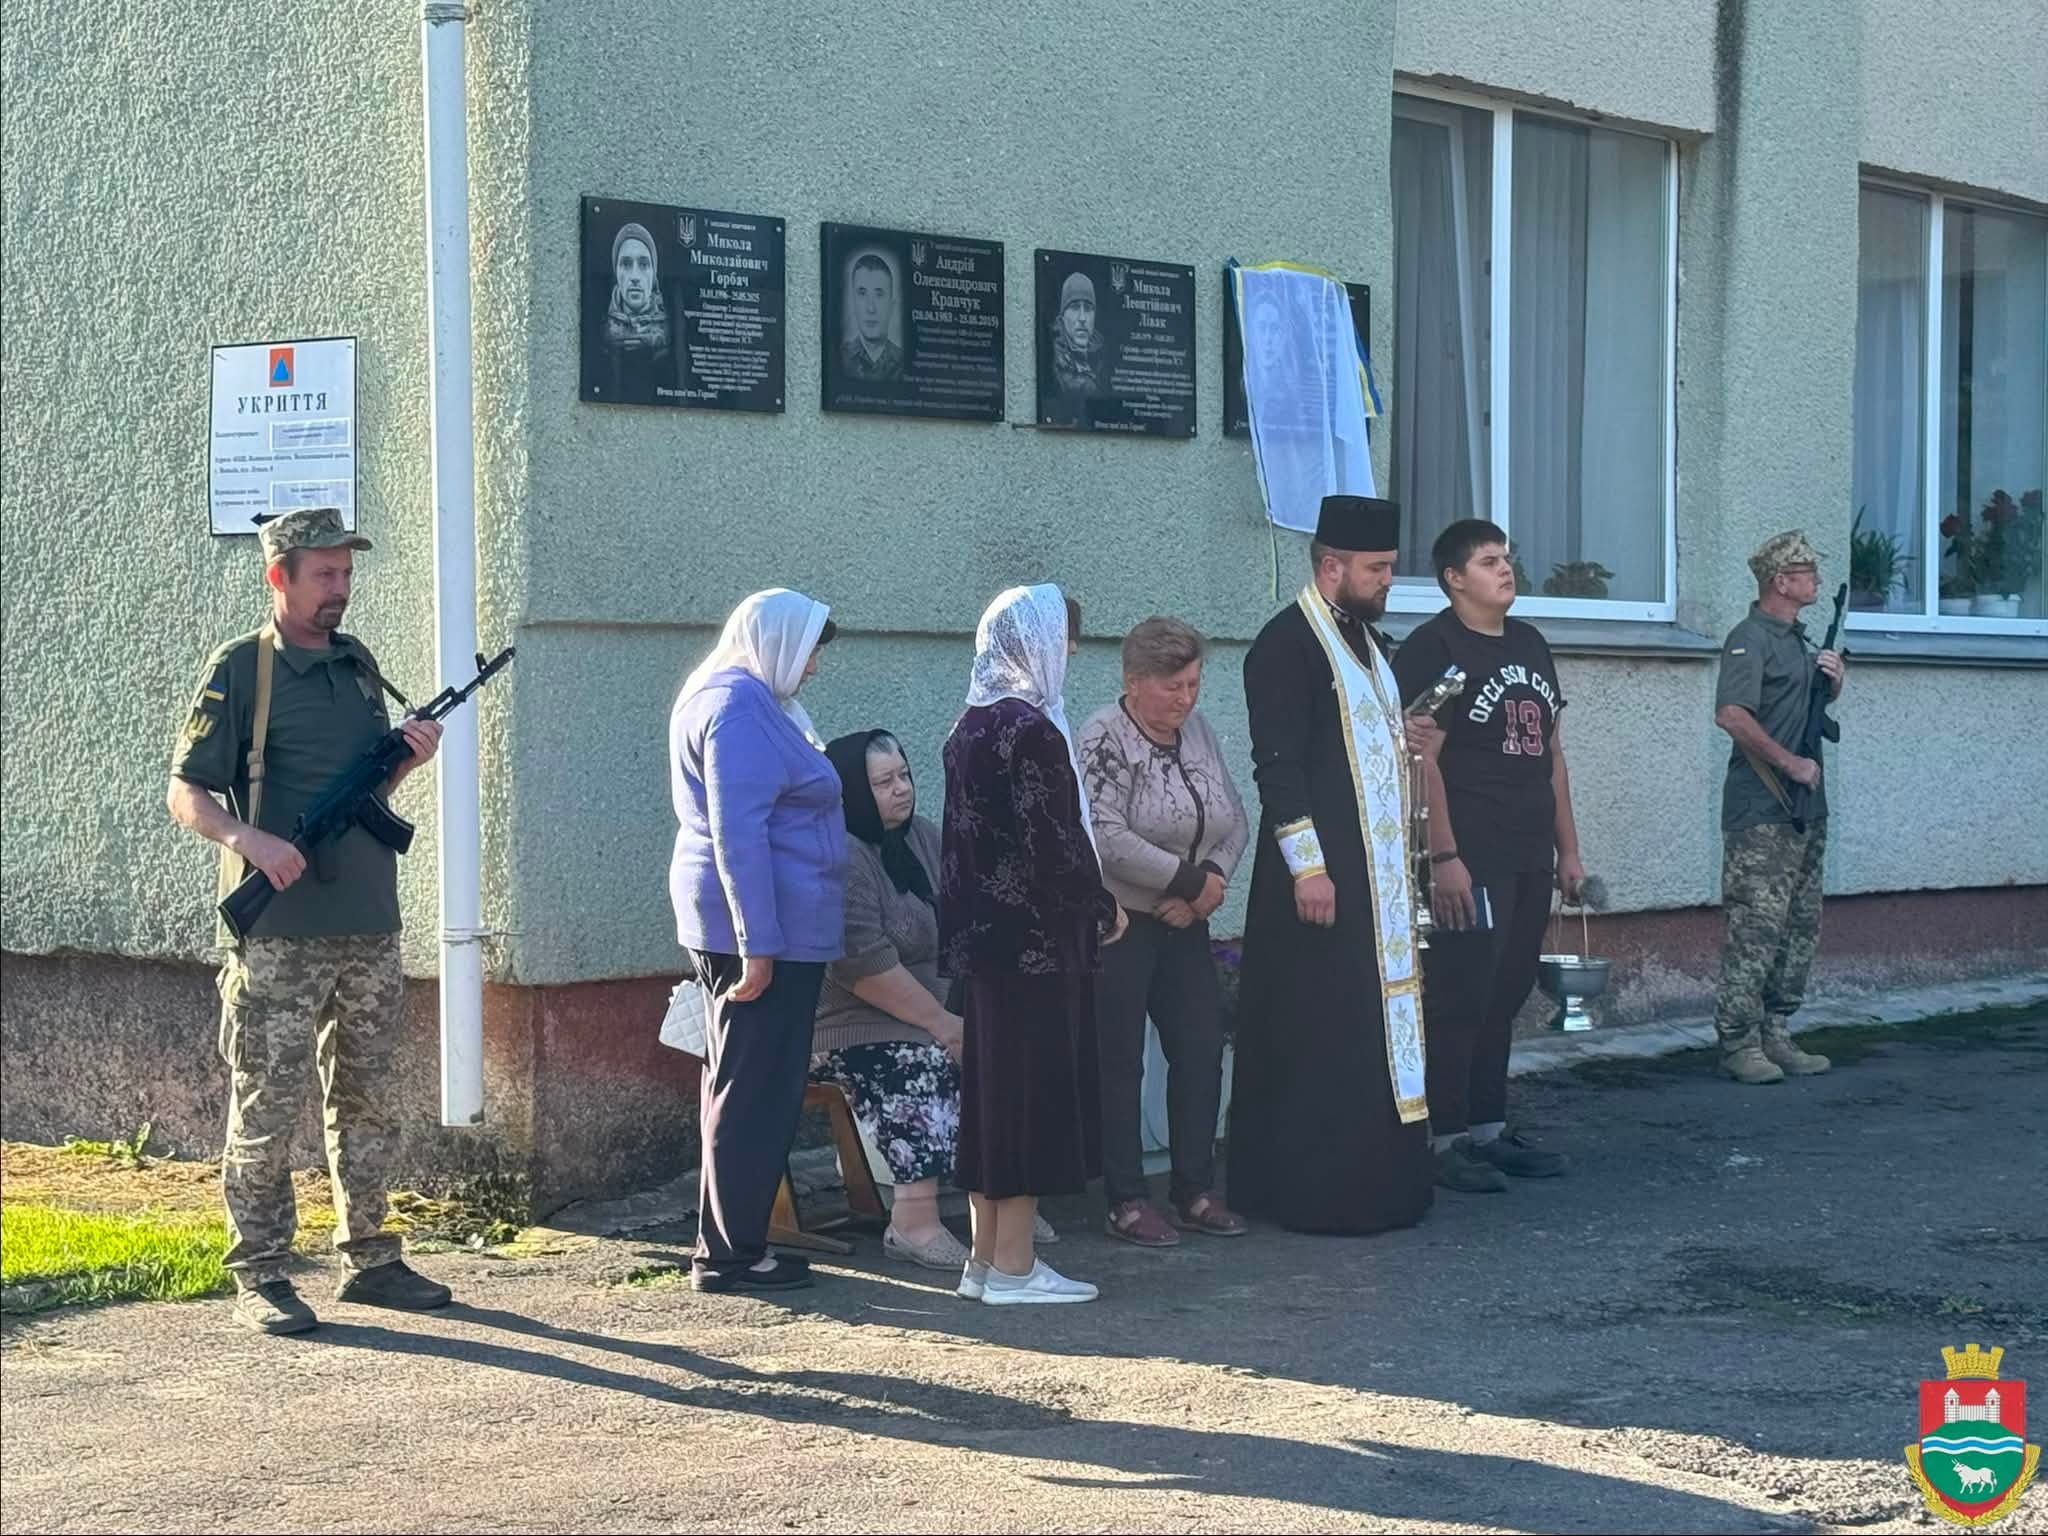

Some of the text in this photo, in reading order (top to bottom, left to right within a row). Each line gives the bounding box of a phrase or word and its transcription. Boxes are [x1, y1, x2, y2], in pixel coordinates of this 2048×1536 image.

[707, 232, 752, 251] Микола
[689, 248, 769, 271] Миколайович
[935, 255, 976, 275] Андрій
[710, 270, 749, 288] Горбач
[912, 271, 998, 294] Олександрович
[930, 289, 981, 313] Кравчук
[237, 392, 328, 415] УКРИТТЯ
[1468, 677, 1505, 724] OFCL
[1502, 699, 1544, 757] 13
